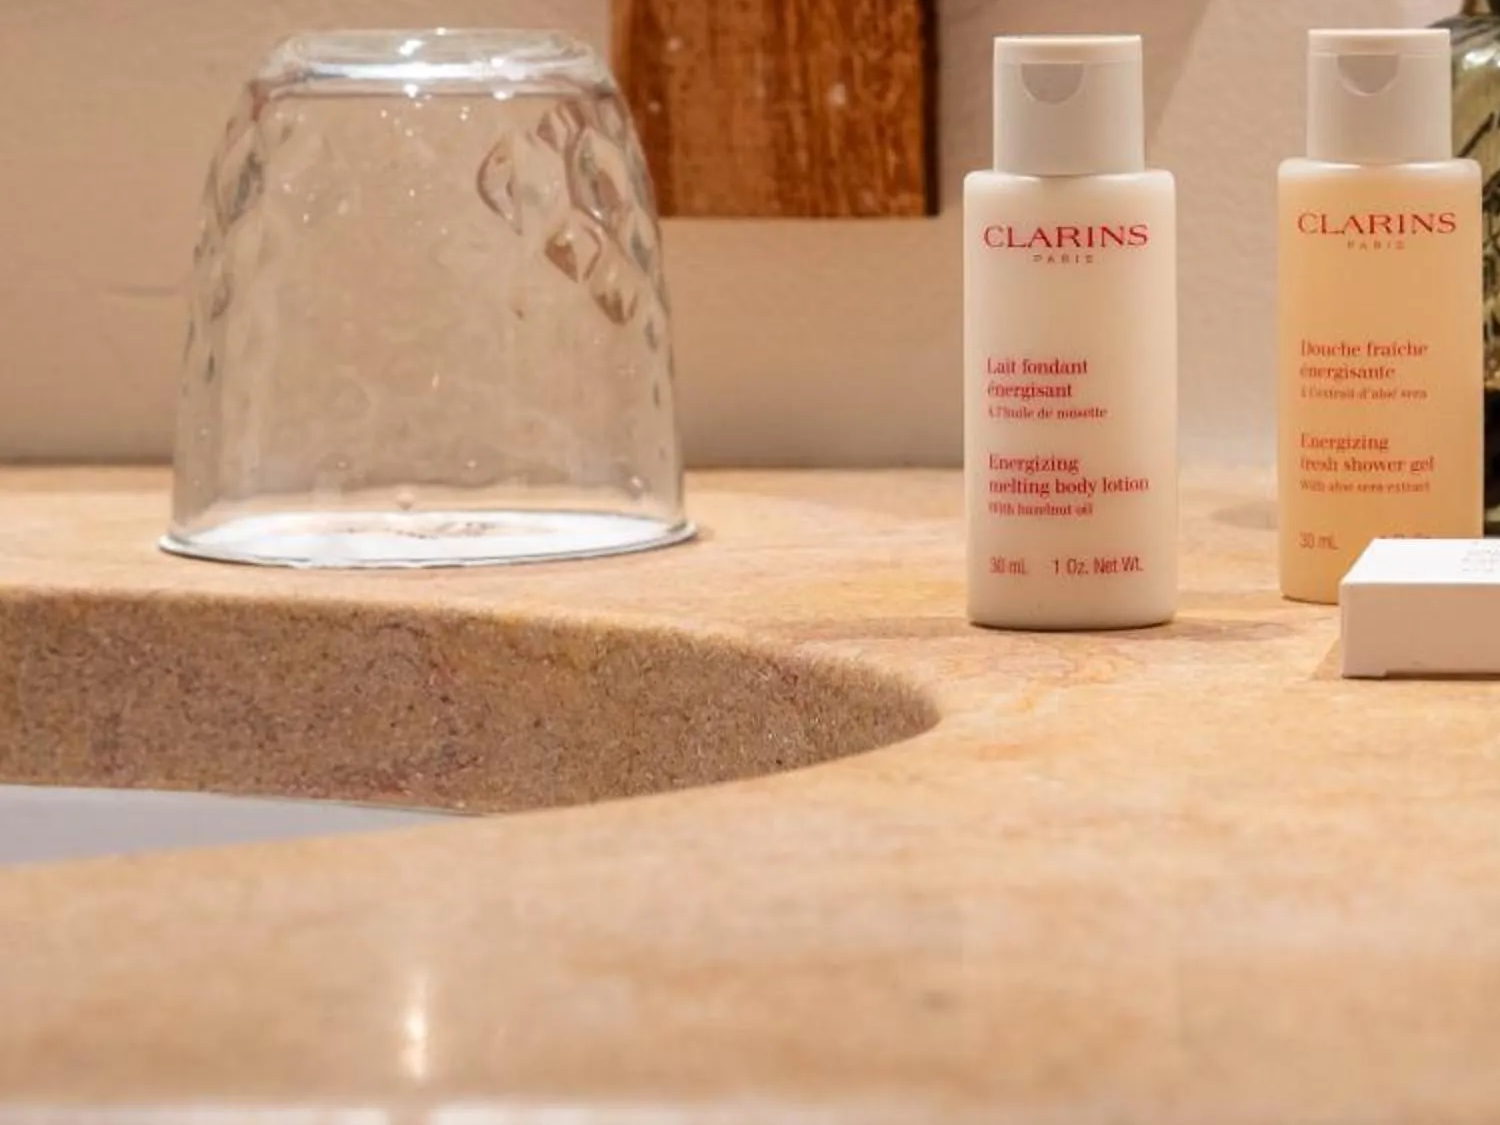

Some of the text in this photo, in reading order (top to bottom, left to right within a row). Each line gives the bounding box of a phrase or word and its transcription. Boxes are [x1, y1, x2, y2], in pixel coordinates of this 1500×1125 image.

[1298, 213, 1457, 235] CLARINS
[984, 224, 1149, 248] CLARINS
[1347, 241, 1405, 250] PARIS
[1033, 254, 1094, 264] PARIS
[1301, 340, 1361, 357] Douche
[987, 356, 1089, 374] Lait fondant
[1300, 362, 1397, 381] énergisante
[987, 380, 1073, 401] énergisant
[1037, 406, 1053, 419] de
[1301, 432, 1389, 453] Energizing
[988, 452, 1080, 474] Energizing
[1300, 455, 1435, 475] fresh shower gel
[988, 475, 1149, 500] melting body lotion
[988, 501, 1016, 515] With
[1299, 532, 1340, 550] 30 mL
[1053, 559, 1060, 574] 1
[1093, 557, 1118, 574] Net
